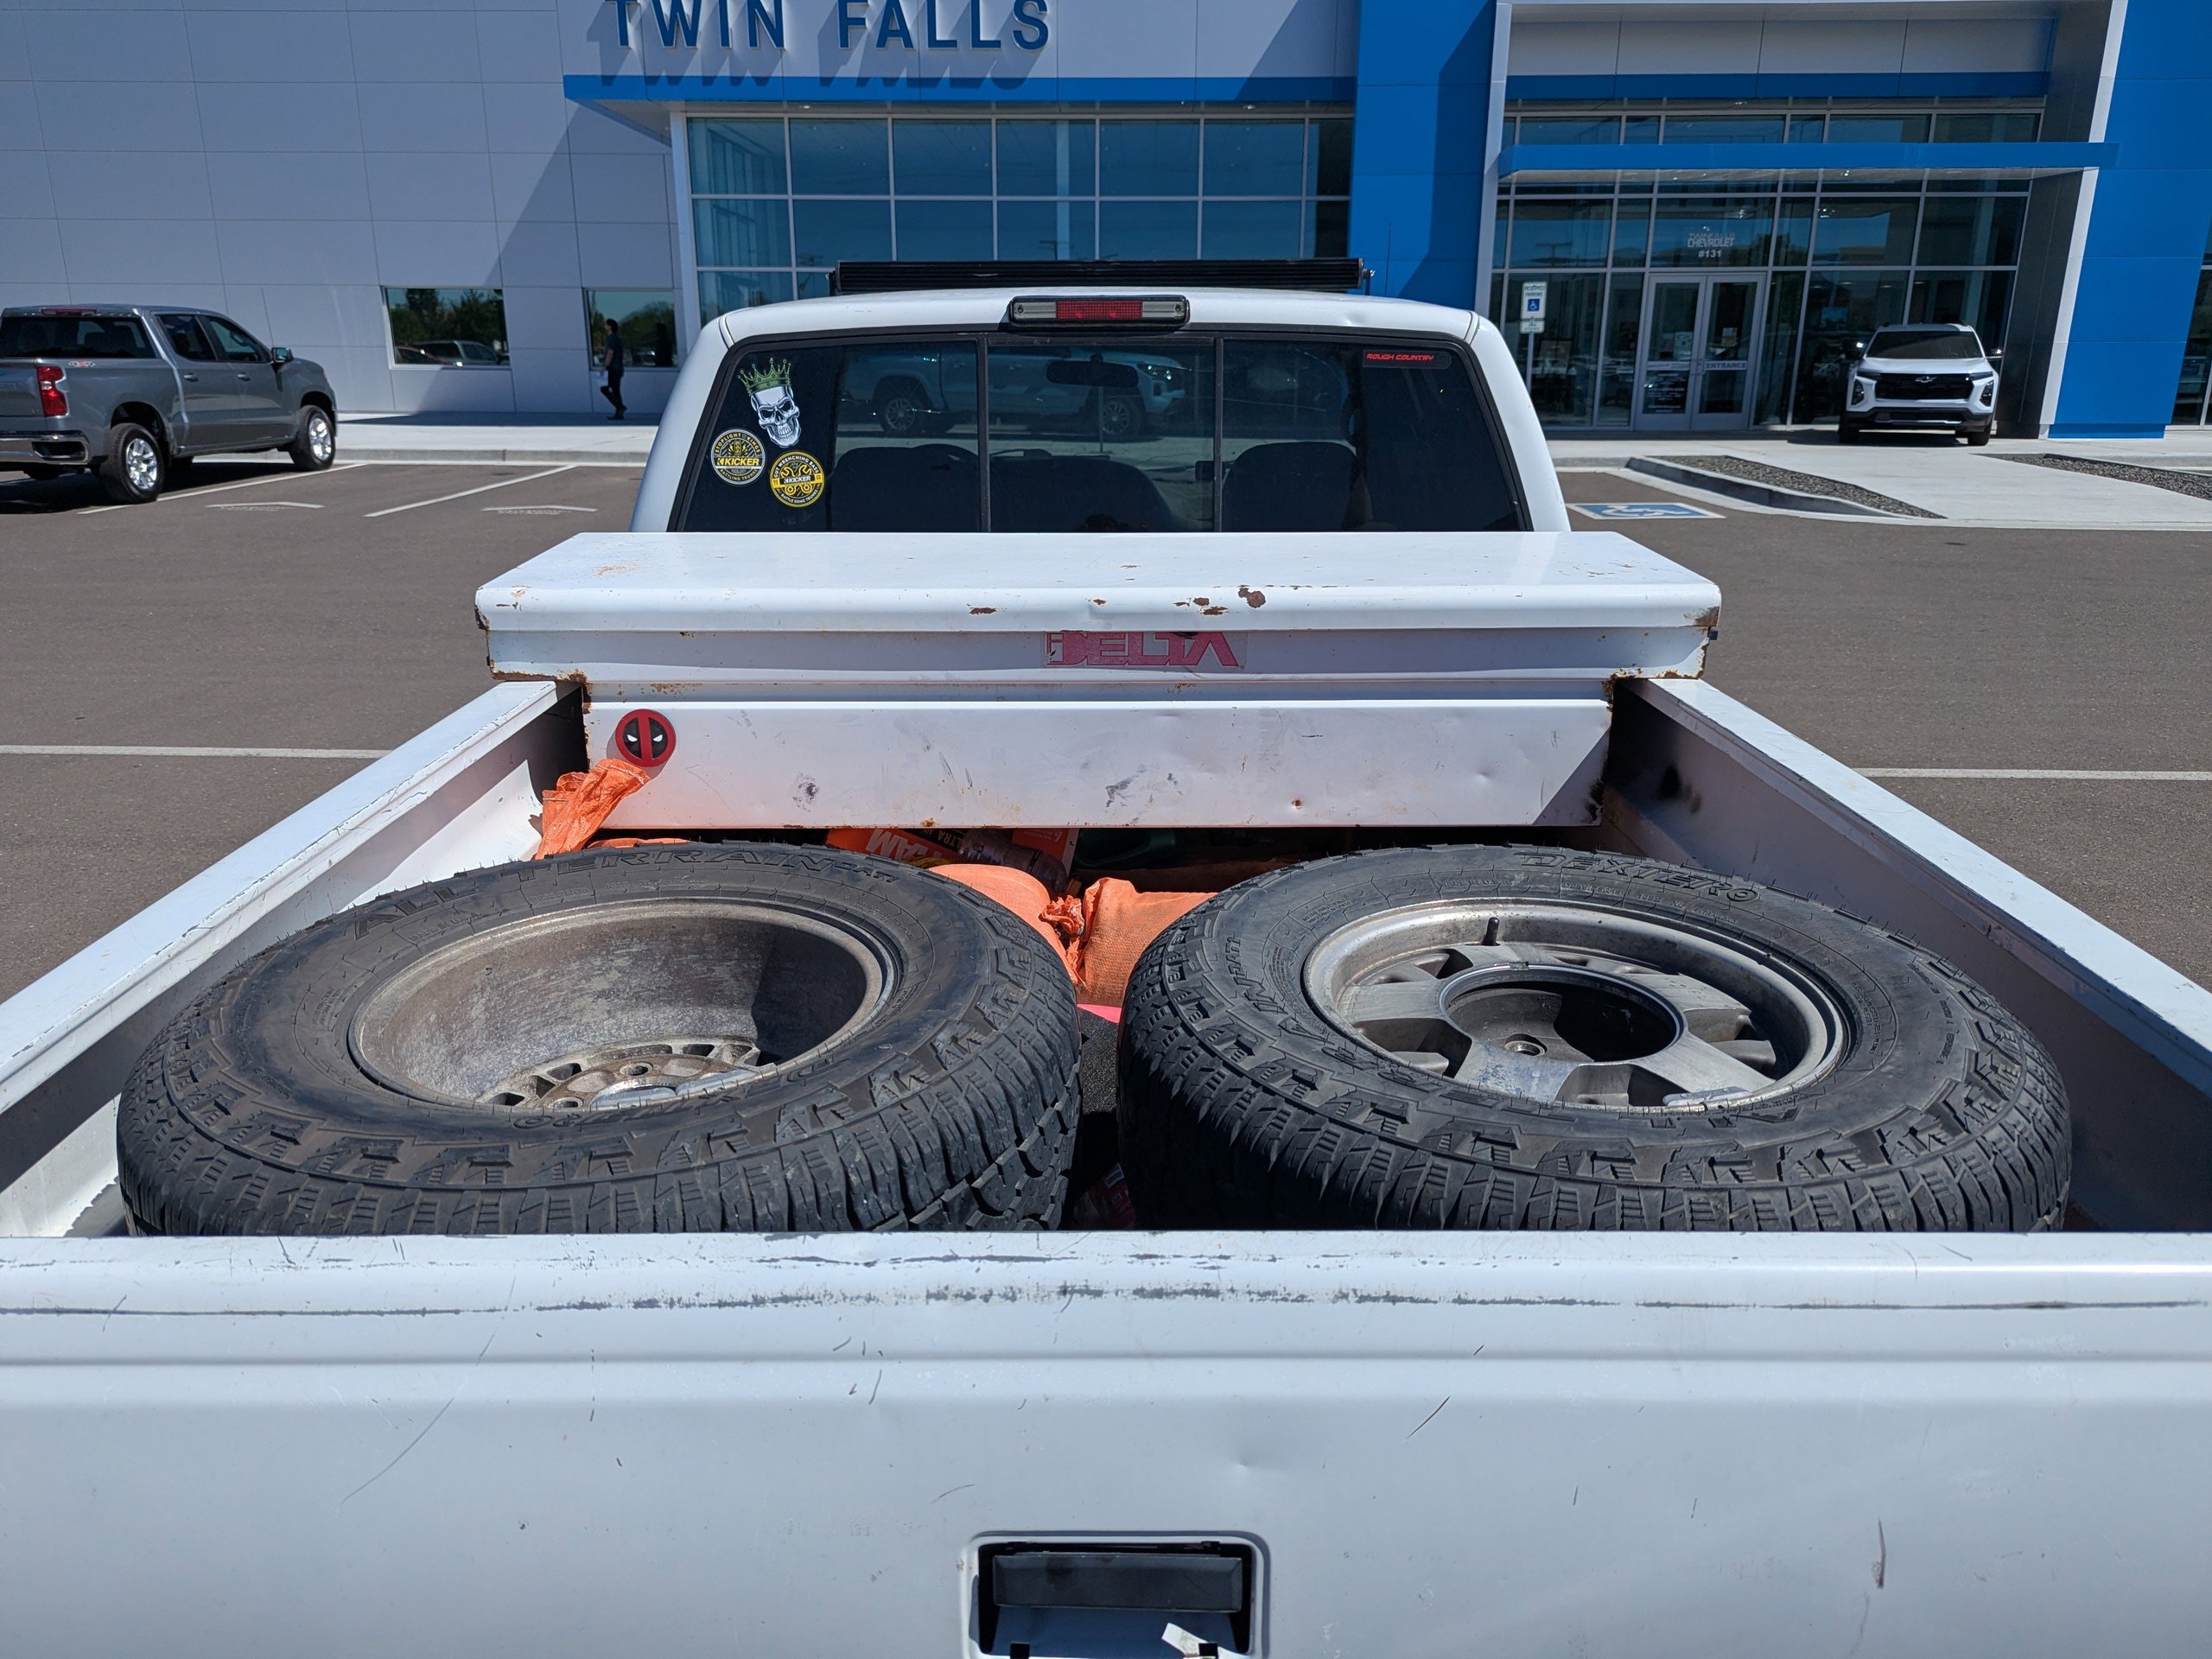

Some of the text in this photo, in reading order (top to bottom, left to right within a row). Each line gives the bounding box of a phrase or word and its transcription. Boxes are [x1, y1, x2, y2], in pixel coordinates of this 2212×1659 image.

[617, 0, 1049, 50] TWIN FALLS
[1687, 238, 1733, 248] CHEVROLET
[1698, 249, 1722, 258] #131
[715, 433, 761, 454] STOPLIGHT KINGS
[778, 455, 810, 467] WRENCHING
[809, 461, 819, 474] BASS
[786, 475, 811, 484] KICKER
[1046, 631, 1240, 667] DELTA
[1514, 852, 1759, 902] DEXTERO
[355, 887, 478, 940] ALL
[500, 849, 831, 882] TERRAIN
